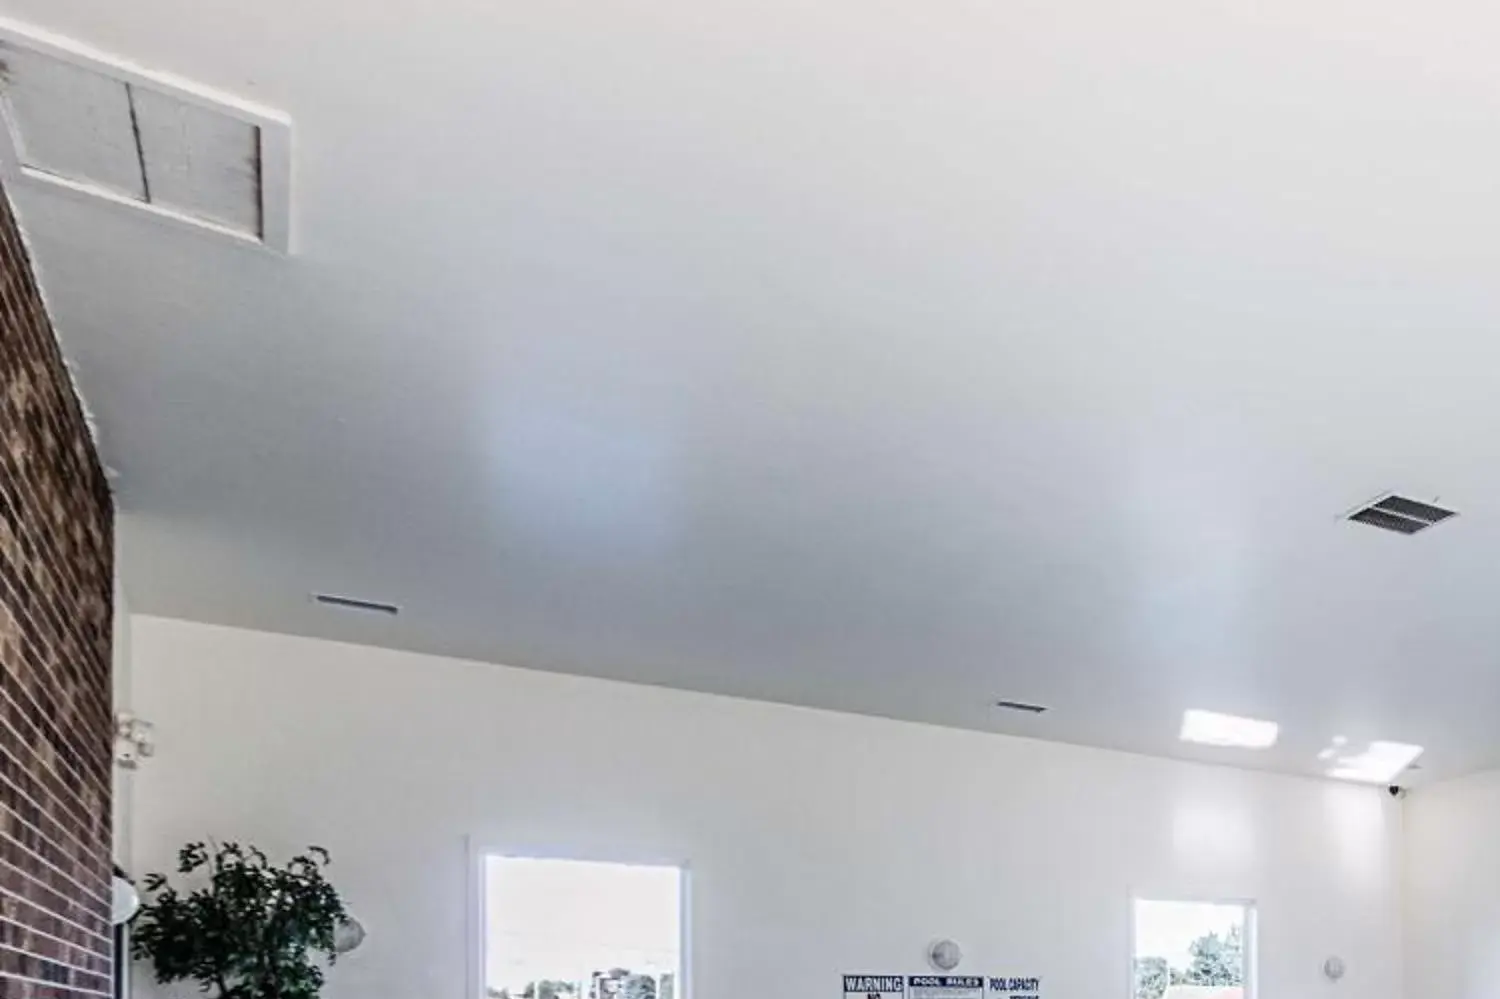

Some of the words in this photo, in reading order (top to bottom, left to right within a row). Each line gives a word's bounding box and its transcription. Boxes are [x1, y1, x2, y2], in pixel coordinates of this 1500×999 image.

[846, 977, 902, 991] WARNING
[989, 978, 1007, 991] POOL
[1008, 977, 1040, 991] CAPACITY
